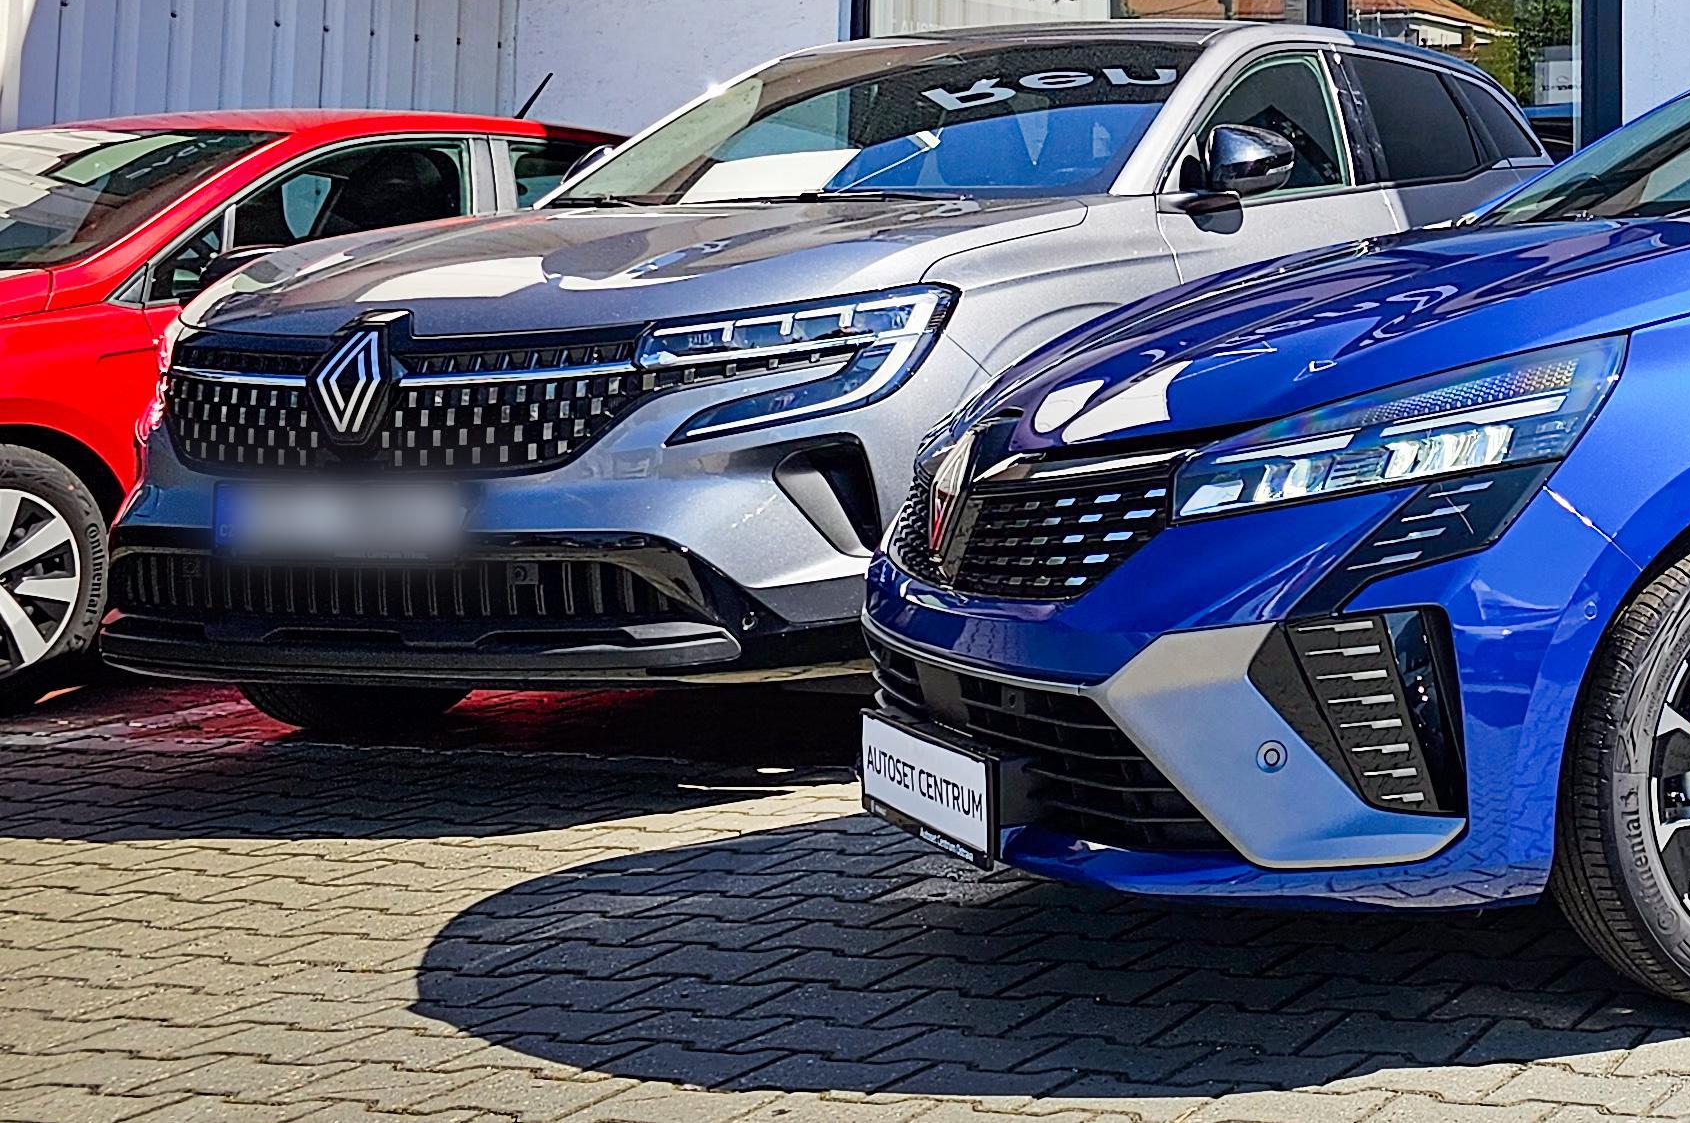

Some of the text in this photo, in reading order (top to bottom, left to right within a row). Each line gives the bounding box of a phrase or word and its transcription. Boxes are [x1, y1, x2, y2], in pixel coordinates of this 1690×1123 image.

[85, 523, 106, 615] Continental
[866, 744, 983, 822] AUTOSET CENTRUM
[1620, 807, 1681, 935] Continental
